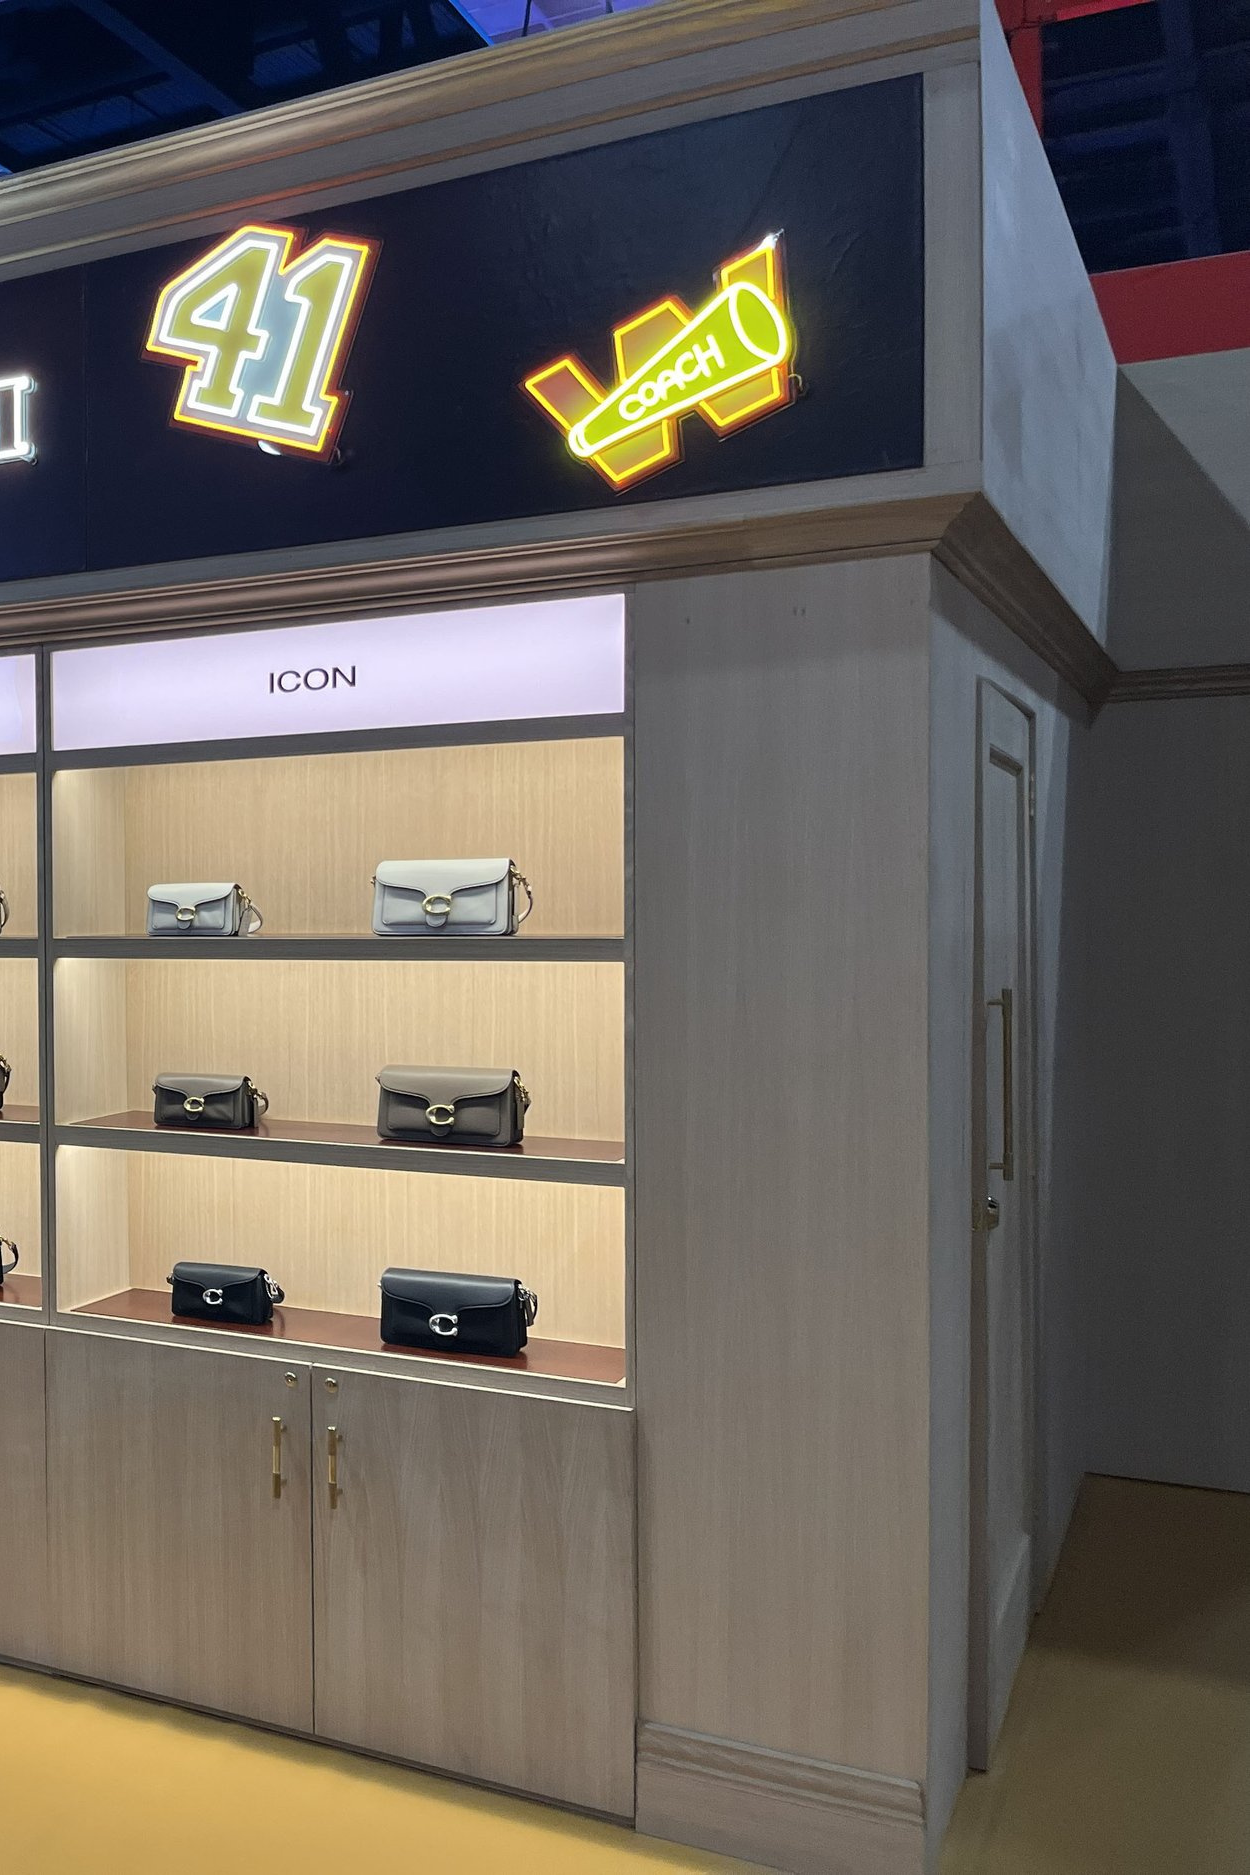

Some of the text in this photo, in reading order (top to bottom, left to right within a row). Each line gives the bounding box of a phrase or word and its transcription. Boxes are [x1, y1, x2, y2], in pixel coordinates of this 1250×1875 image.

[153, 232, 359, 442] 41
[618, 334, 726, 421] COACH
[269, 665, 356, 694] ICON
